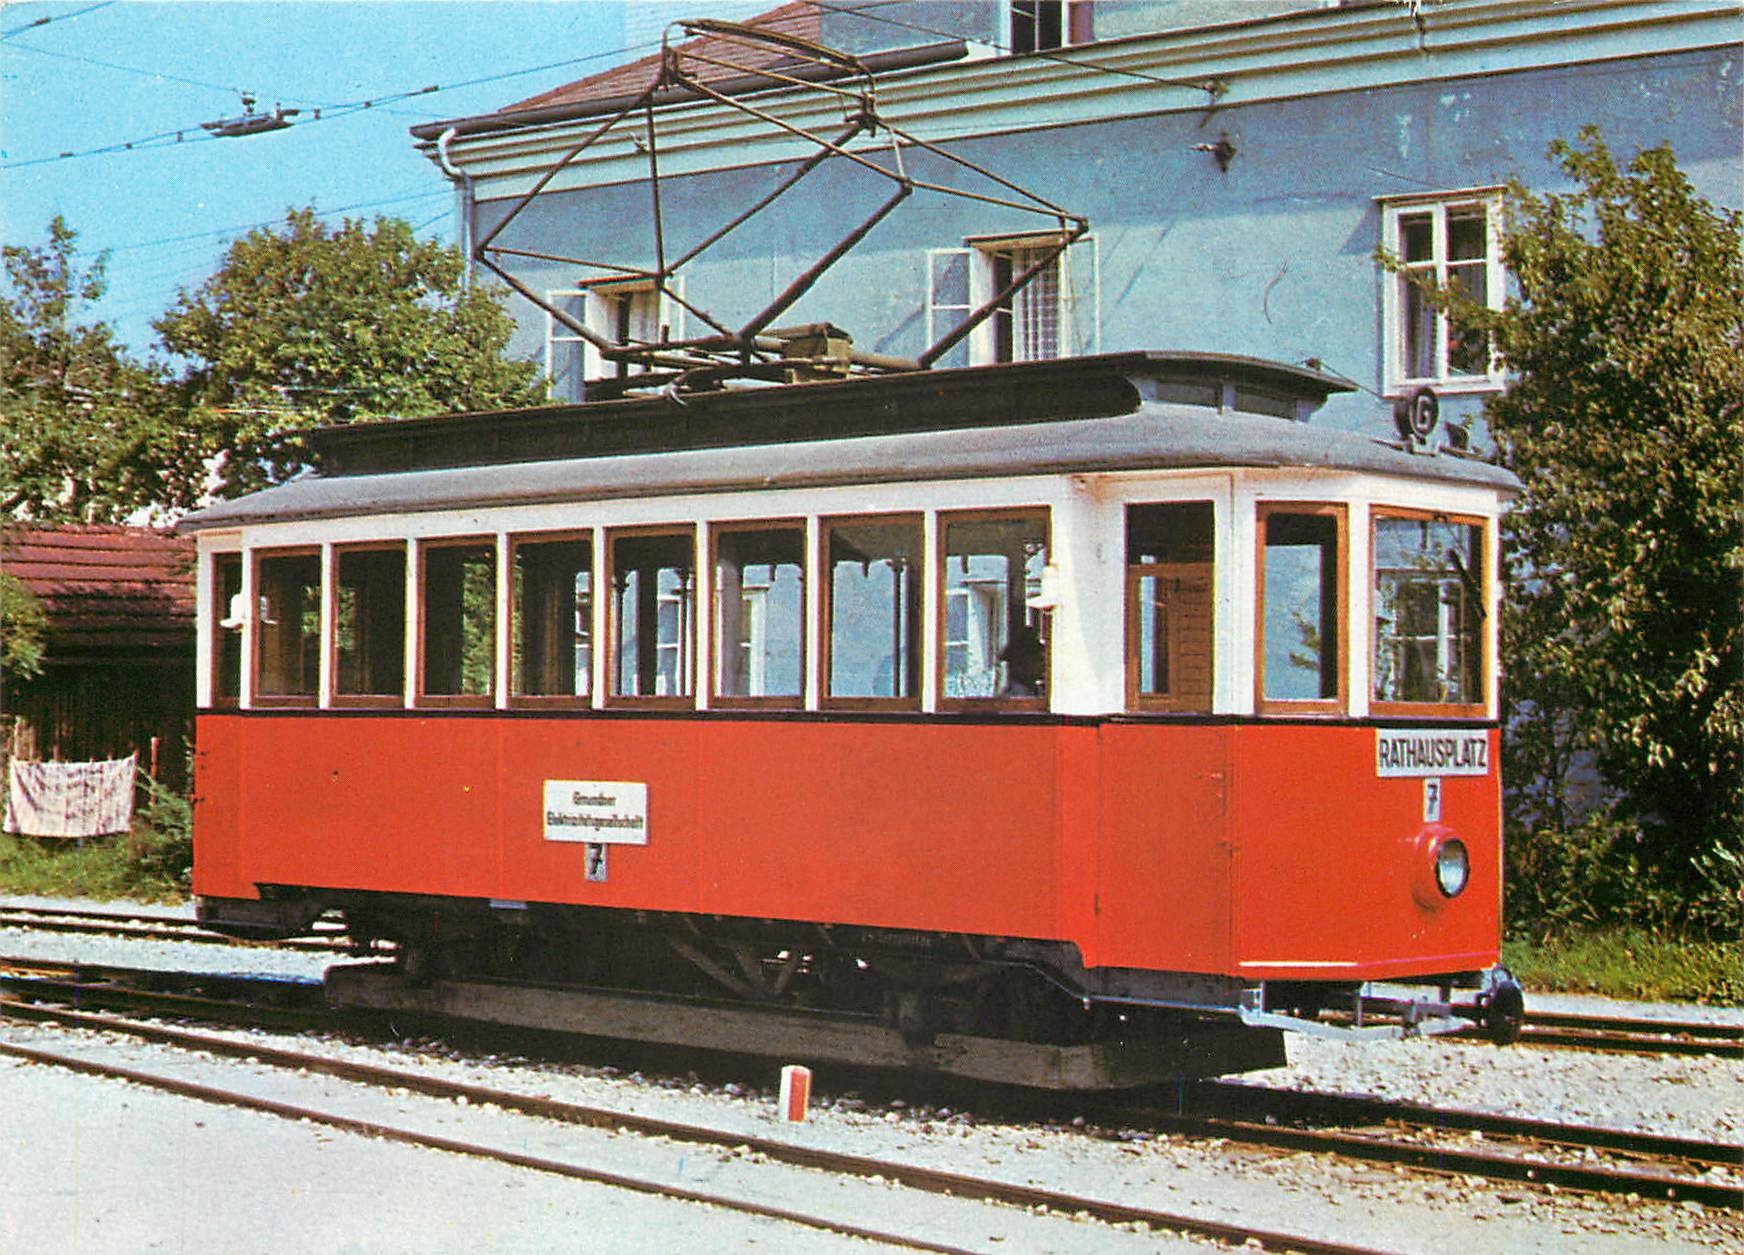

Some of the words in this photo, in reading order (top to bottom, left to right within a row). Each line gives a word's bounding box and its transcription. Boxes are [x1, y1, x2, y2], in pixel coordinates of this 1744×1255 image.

[1379, 738, 1487, 768] RATHAUSPLATZ
[1427, 783, 1438, 815] 7
[590, 843, 603, 875] 7
